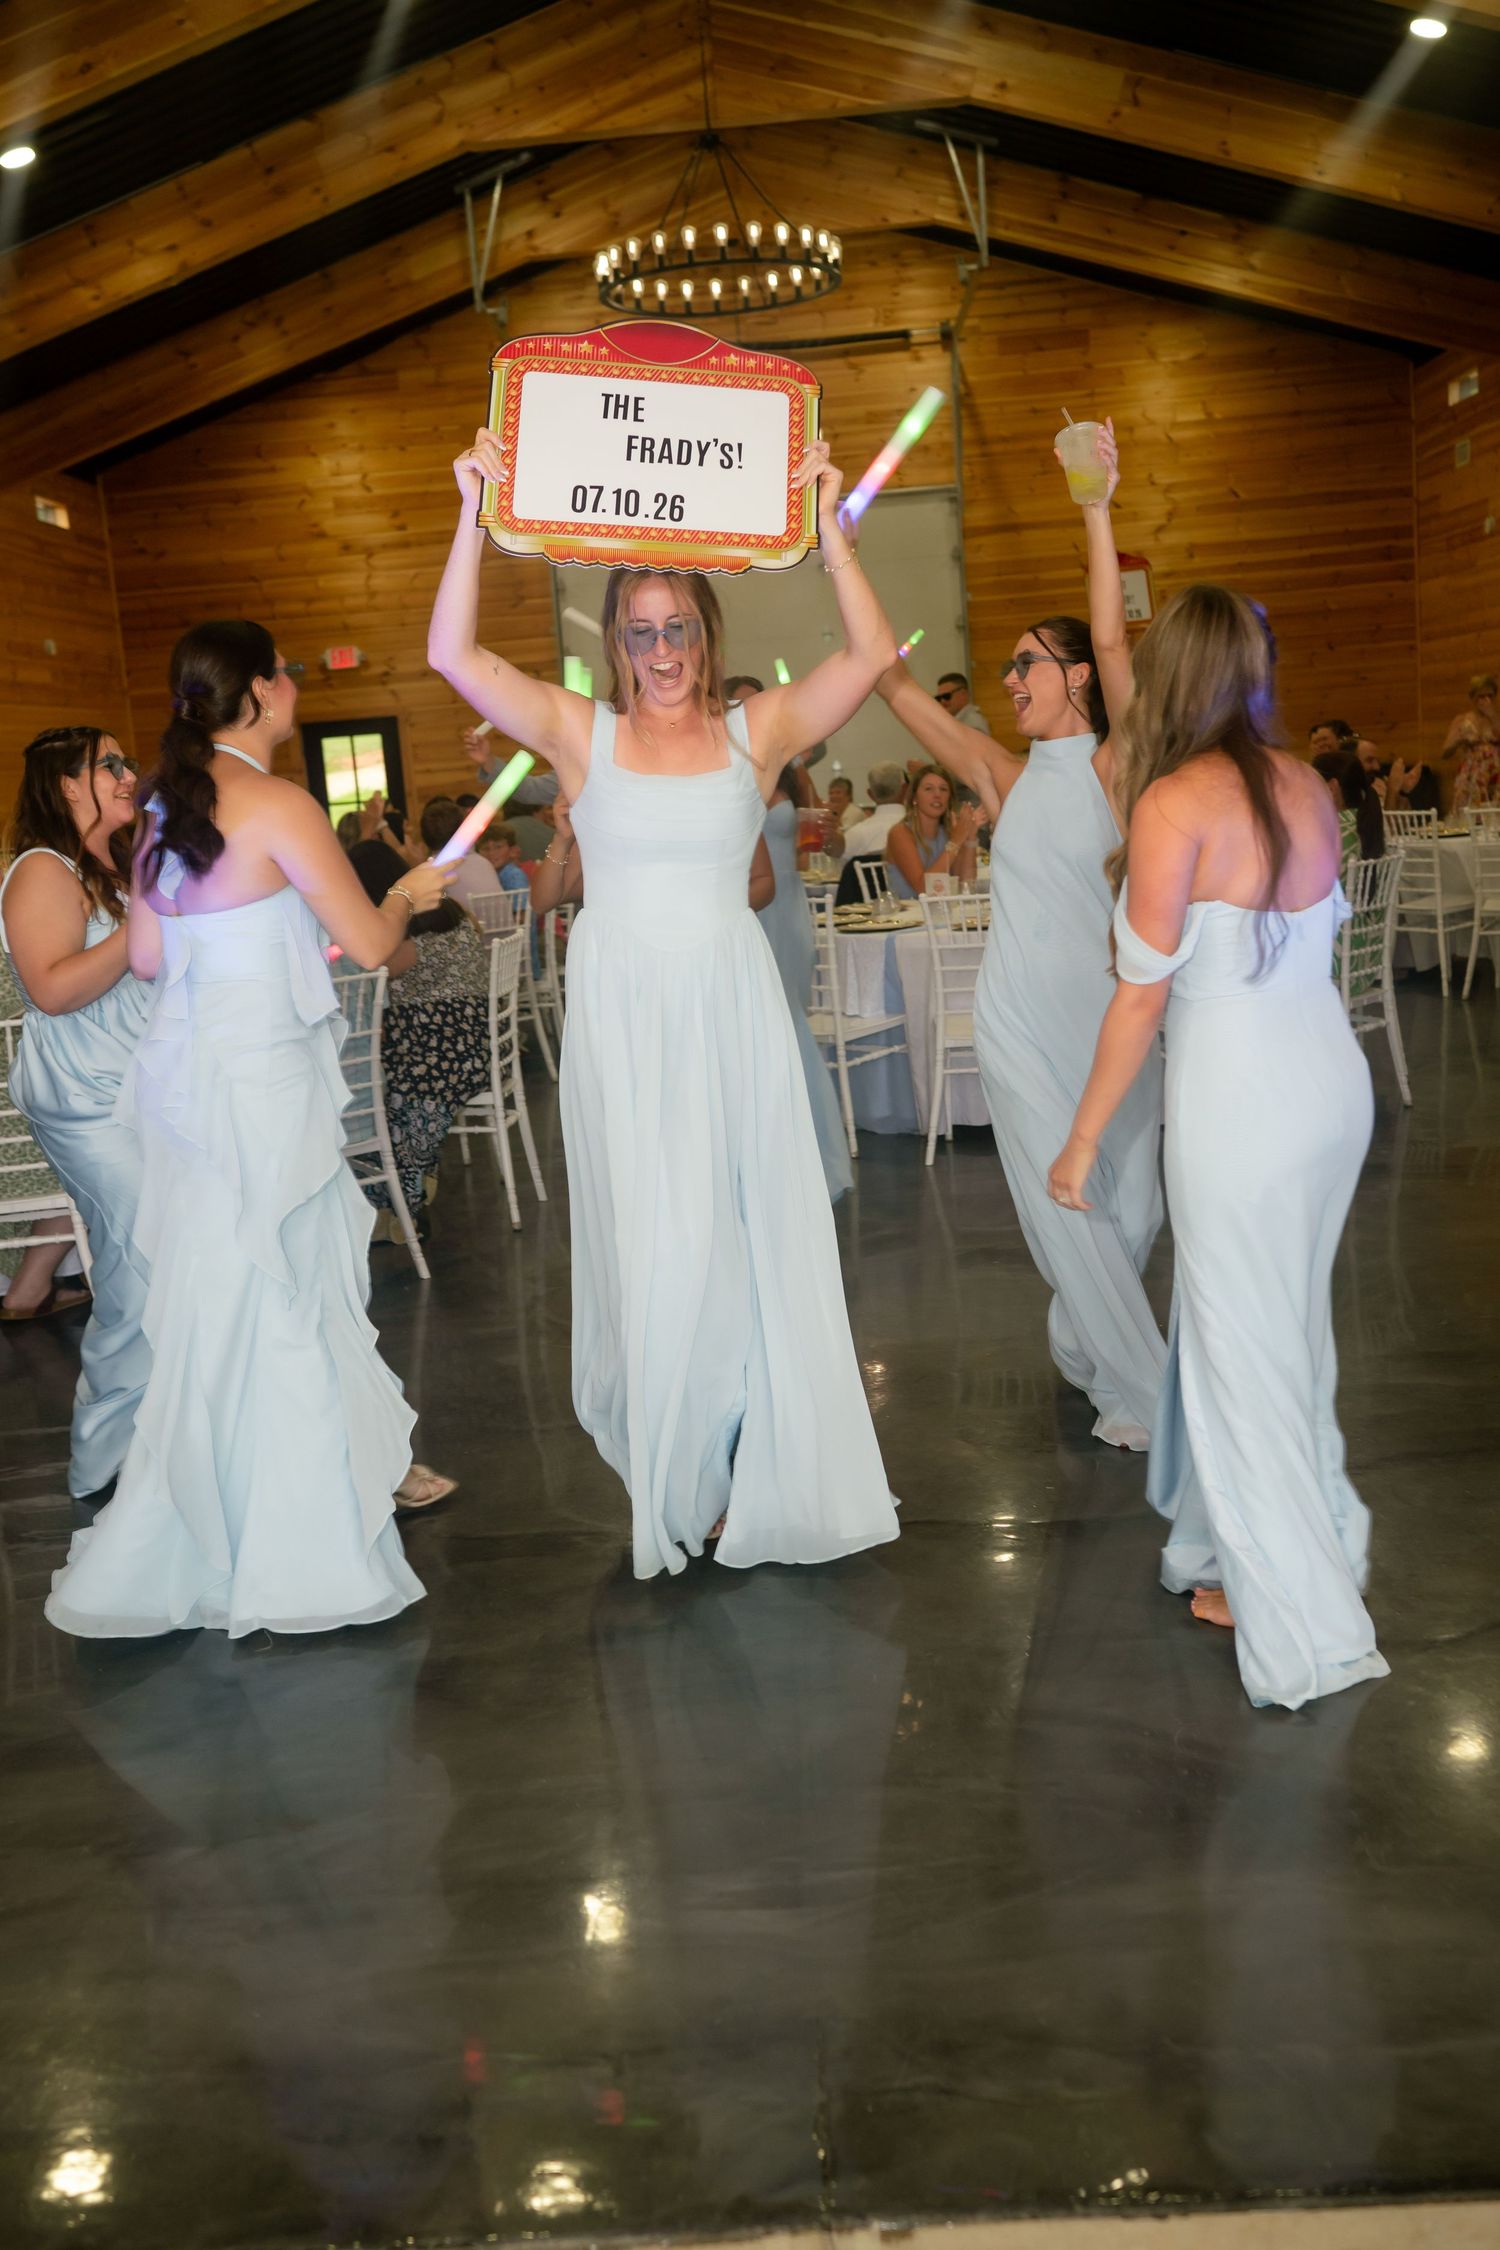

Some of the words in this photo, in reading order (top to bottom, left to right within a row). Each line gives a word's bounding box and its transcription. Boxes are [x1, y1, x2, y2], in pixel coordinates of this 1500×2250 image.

[601, 392, 645, 423] THE
[626, 434, 744, 470] FRADY'S!
[570, 485, 685, 523] 07.10.26
